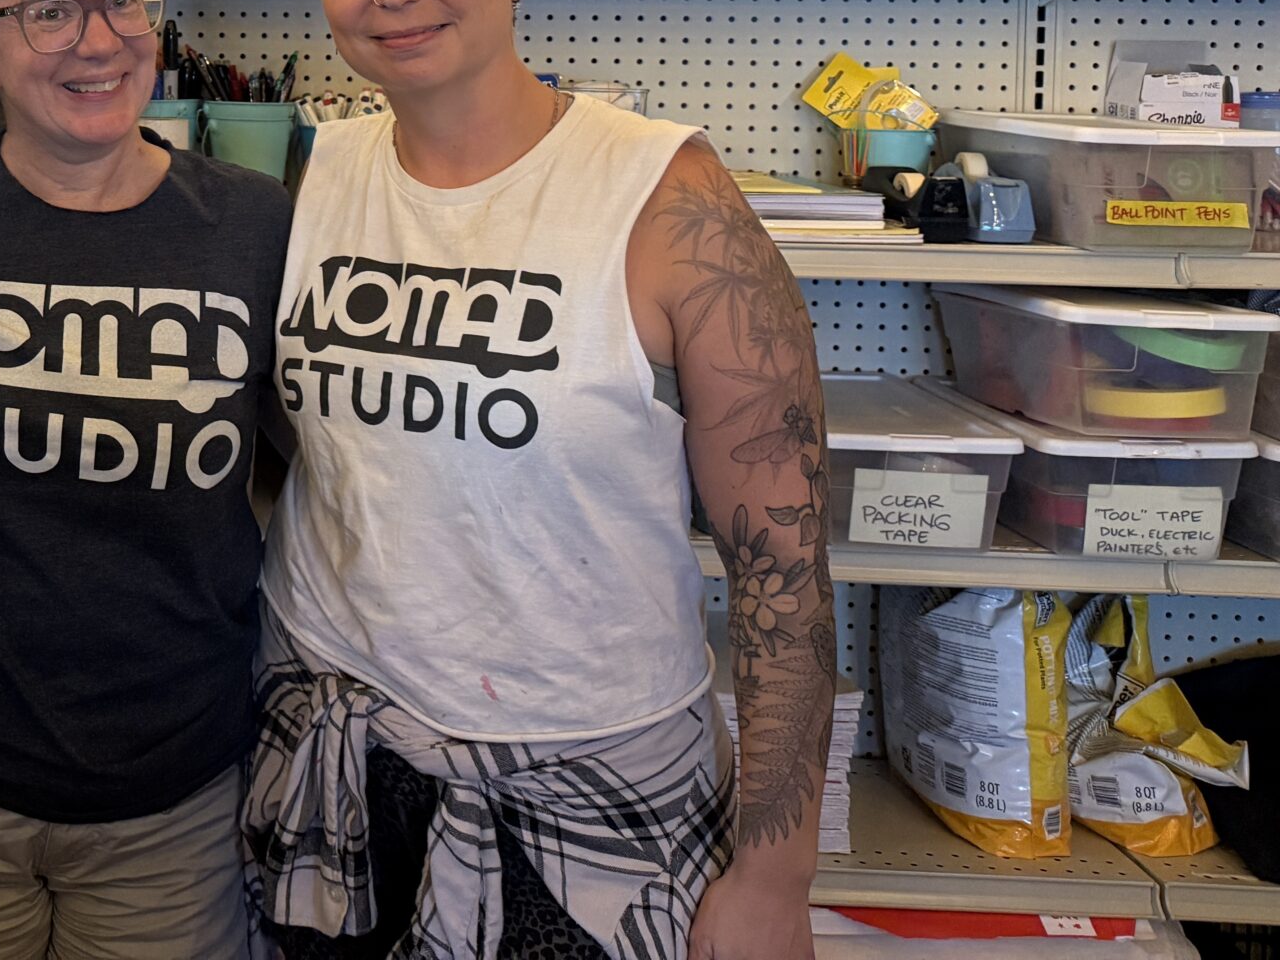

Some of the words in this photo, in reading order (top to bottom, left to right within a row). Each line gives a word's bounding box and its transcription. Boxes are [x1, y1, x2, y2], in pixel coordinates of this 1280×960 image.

[828, 90, 846, 110] Post-it
[1196, 205, 1231, 221] PENS
[281, 357, 539, 450] STUDIO
[881, 494, 944, 509] CLEAR
[862, 505, 952, 532] PACKING
[1095, 508, 1147, 523] "TOOL"
[1157, 510, 1203, 523] TAPE
[880, 529, 929, 545] TAPE
[1149, 528, 1215, 542] ELECTRIC
[1173, 545, 1197, 556] etc
[979, 780, 986, 792] 8
[987, 782, 1000, 796] QT
[1135, 786, 1142, 797] 8
[1144, 786, 1157, 798] QT
[975, 795, 995, 810] (8.8
[996, 799, 1007, 813] L)
[1132, 801, 1151, 814] (8.8
